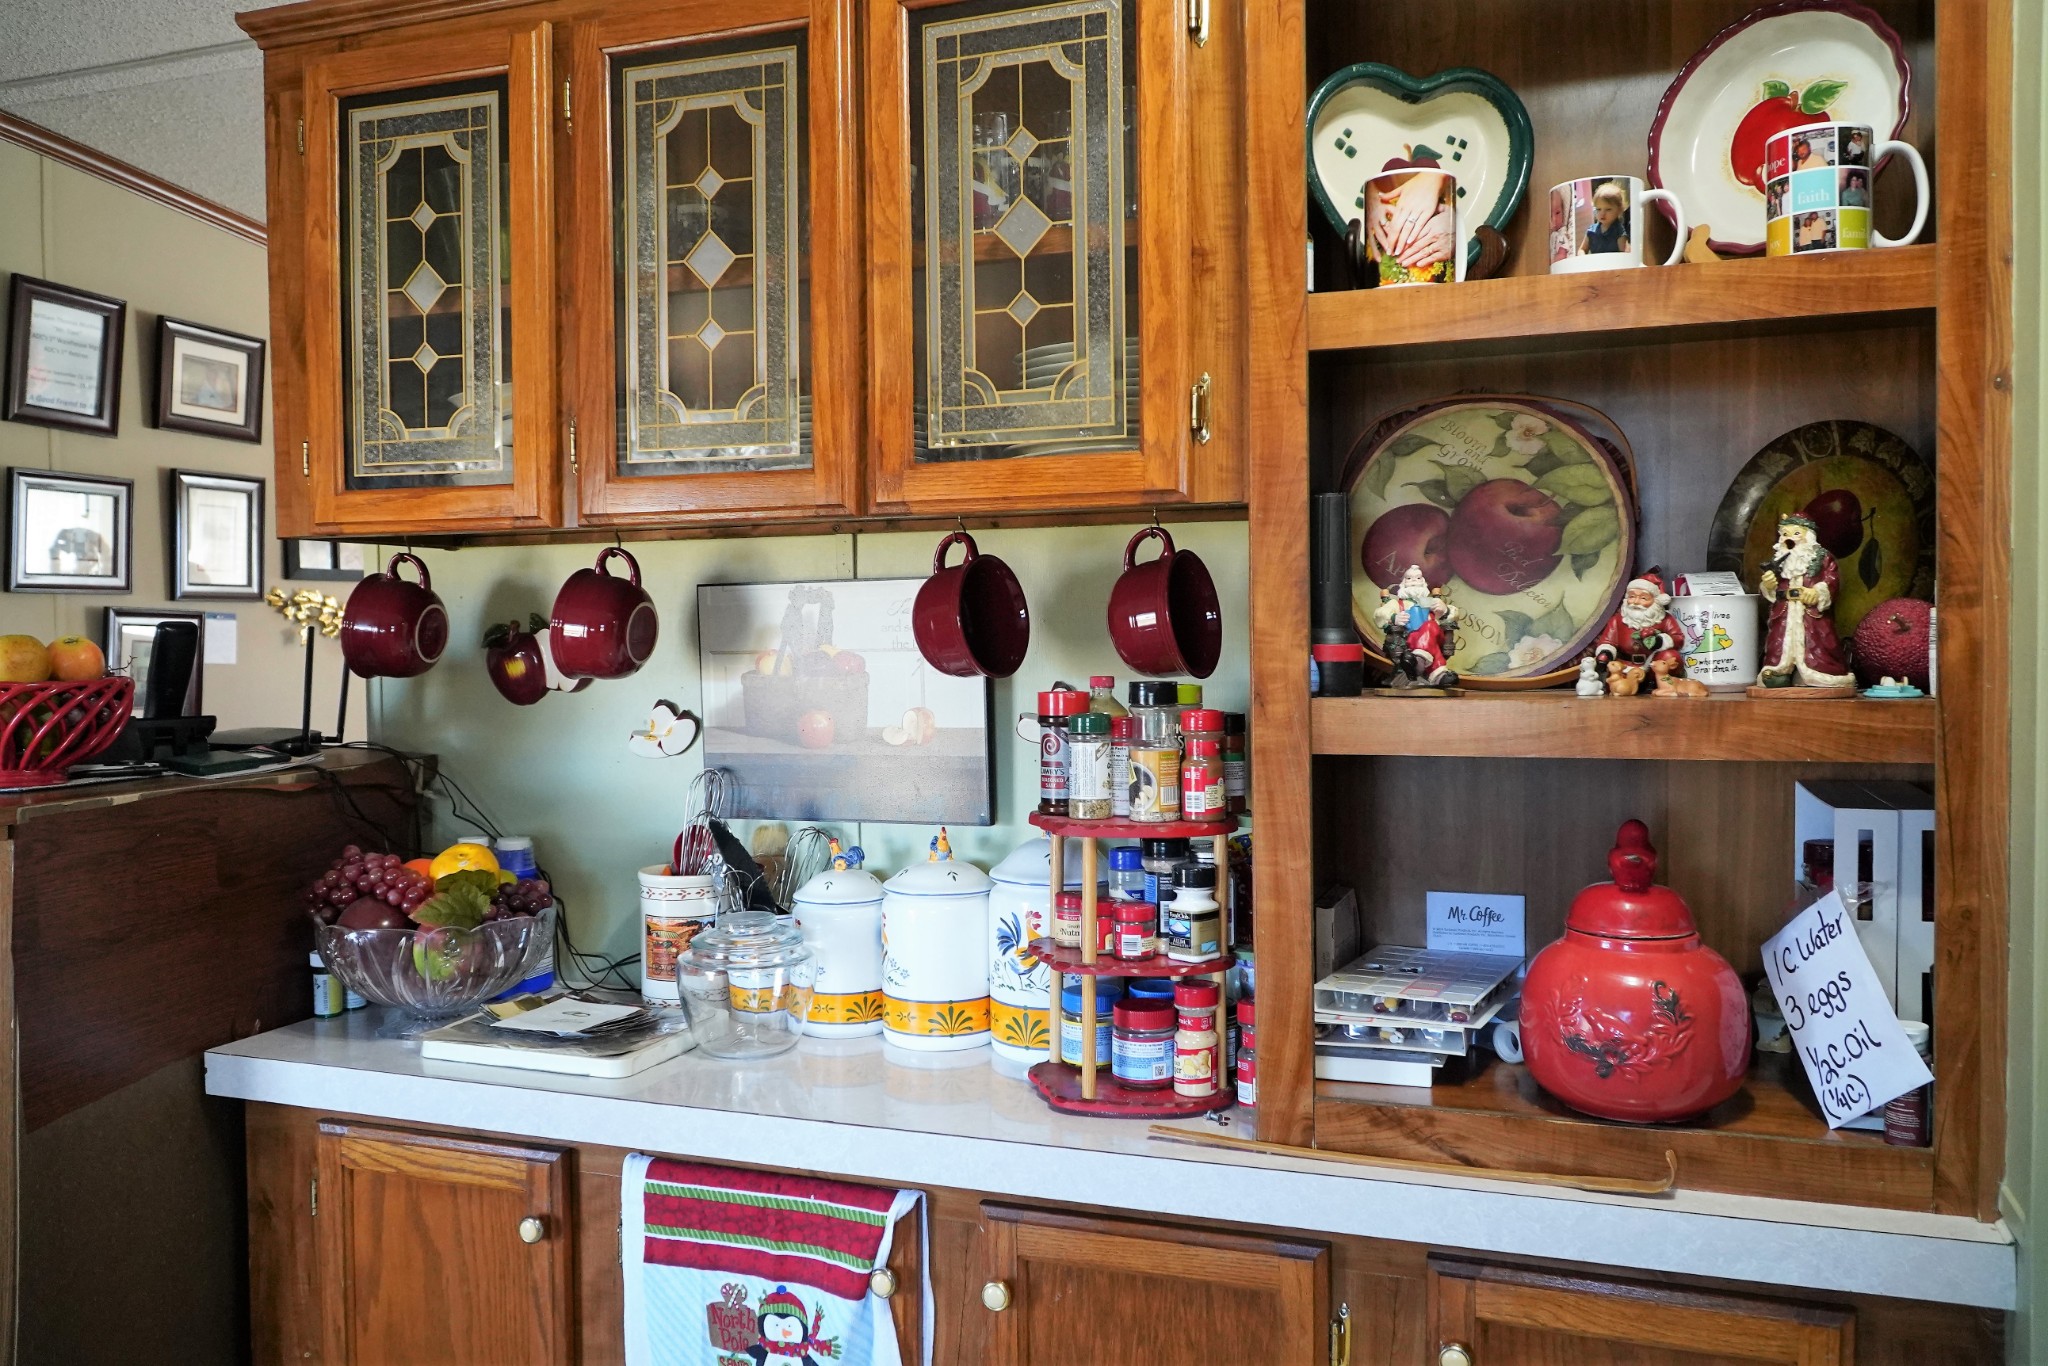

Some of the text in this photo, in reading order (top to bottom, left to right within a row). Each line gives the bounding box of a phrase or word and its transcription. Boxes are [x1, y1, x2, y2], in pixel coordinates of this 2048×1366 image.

[1797, 188, 1830, 205] faith
[1440, 420, 1487, 451] Bloom
[1447, 905, 1505, 928] Mr. Coffee
[1796, 910, 1843, 961] Water
[1785, 971, 1852, 1031] 3 eggs
[711, 1303, 756, 1334] North
[718, 1327, 749, 1351] Pole
